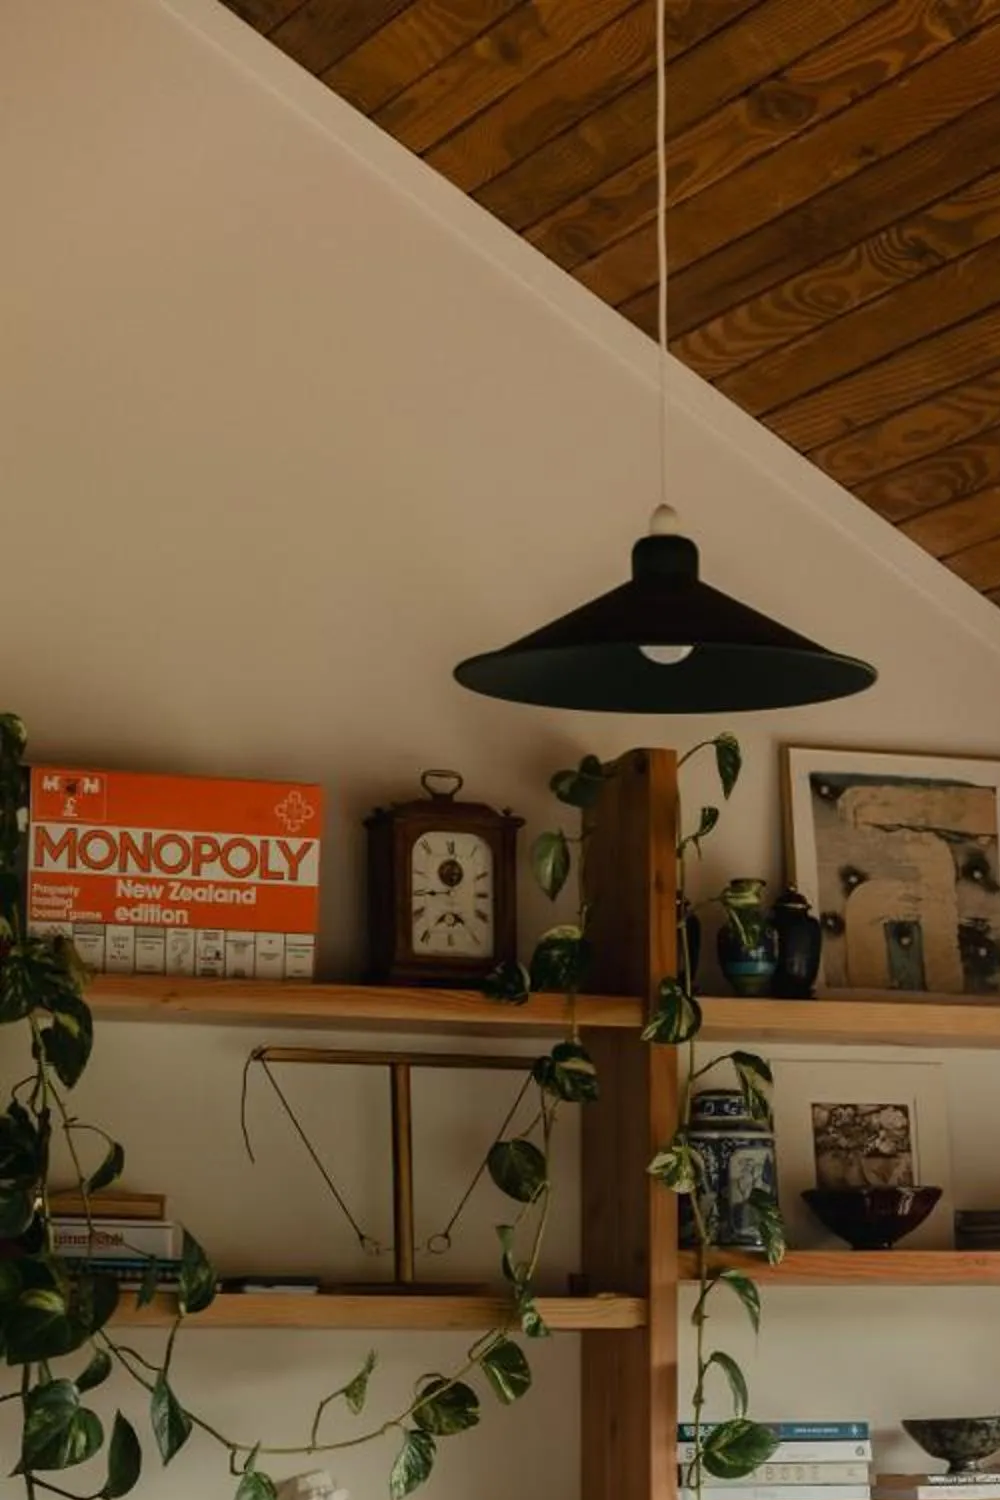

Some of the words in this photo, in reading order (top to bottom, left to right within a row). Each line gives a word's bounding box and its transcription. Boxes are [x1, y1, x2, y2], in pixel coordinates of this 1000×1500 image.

[34, 826, 313, 882] MONOPOLY
[116, 879, 164, 900] New
[168, 881, 257, 904] Zealand
[115, 903, 189, 925] edition
